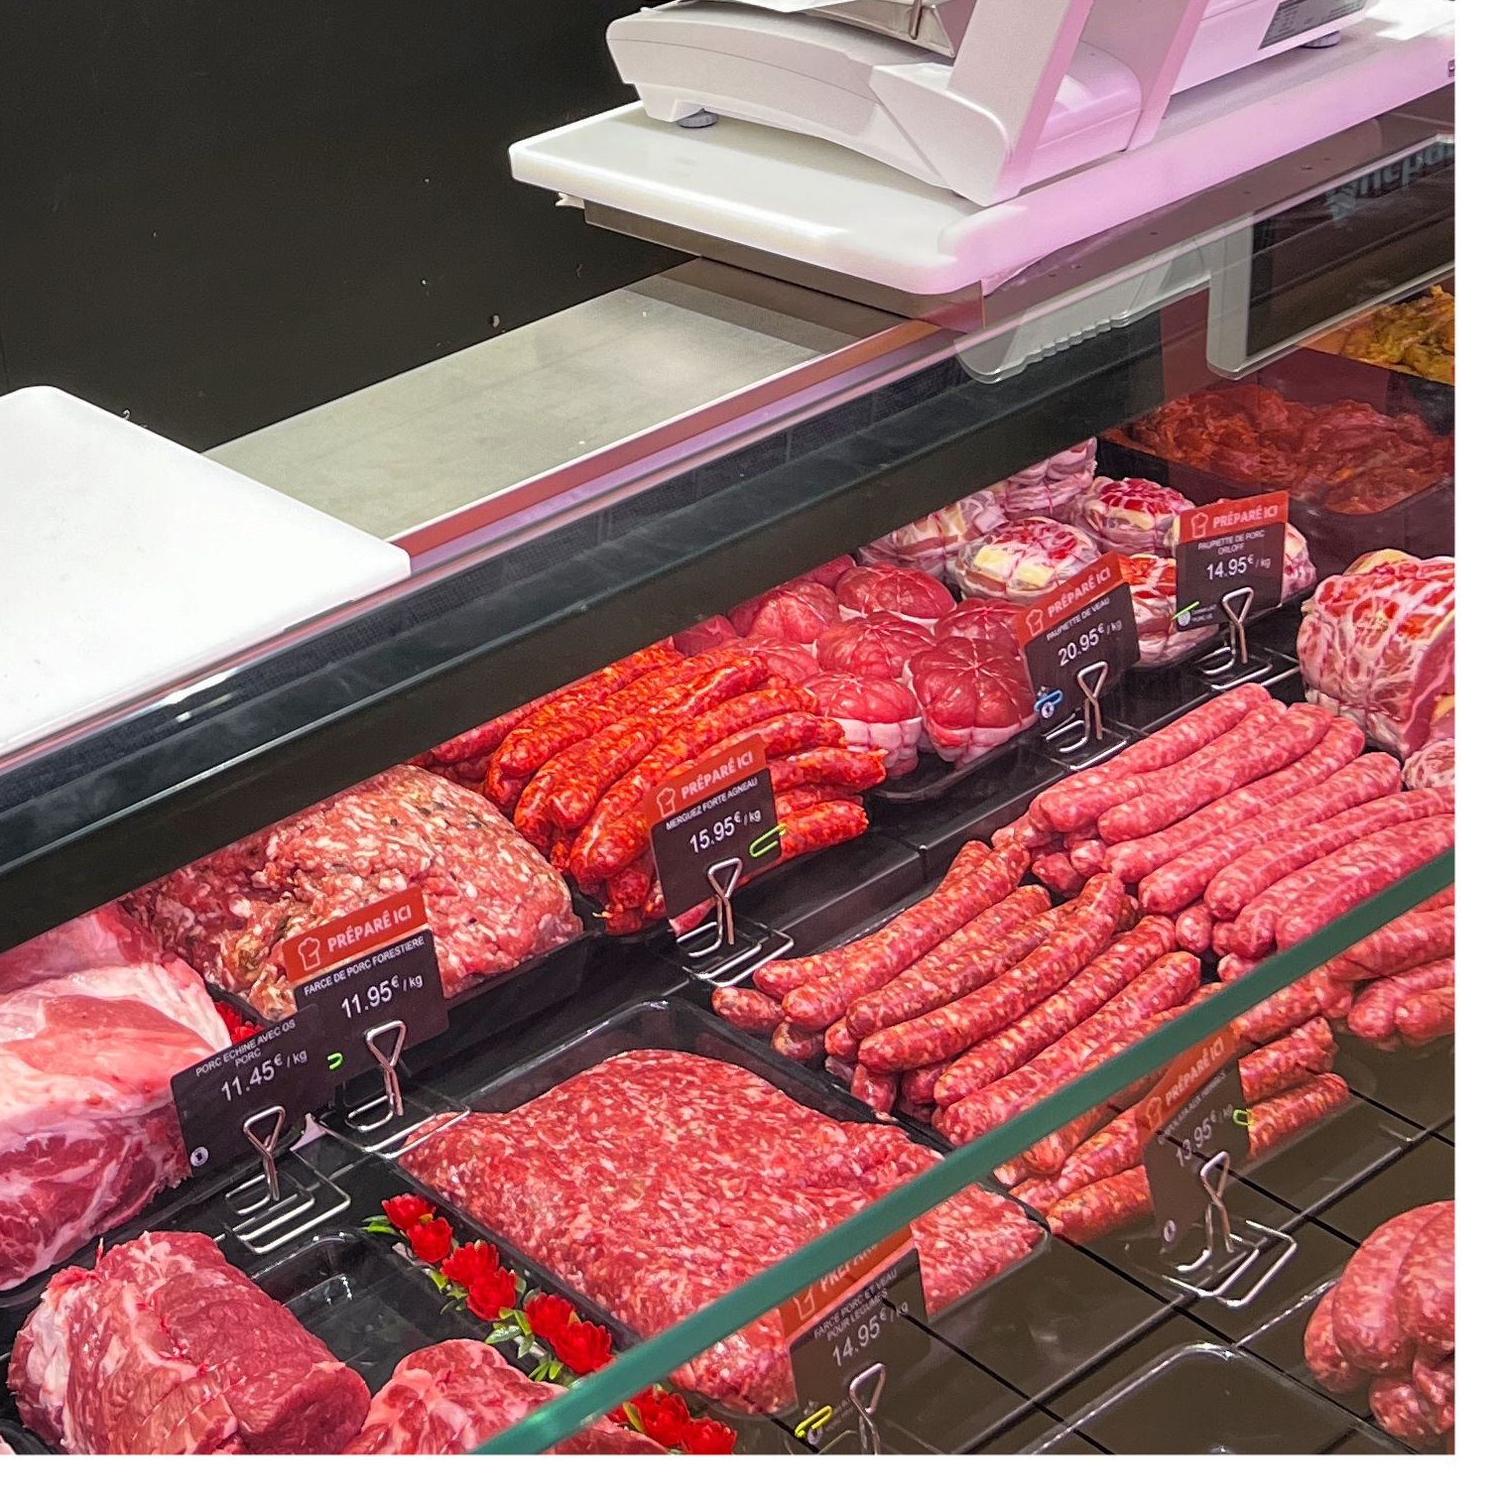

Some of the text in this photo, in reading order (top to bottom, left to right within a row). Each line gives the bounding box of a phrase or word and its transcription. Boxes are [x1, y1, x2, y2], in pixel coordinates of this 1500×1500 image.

[1213, 505, 1263, 528] PRÉPARÉ
[1234, 533, 1245, 542] DE
[1245, 529, 1265, 540] PORC
[1218, 542, 1245, 555] ORLOFF
[1047, 567, 1111, 618] PRÉPARÉ ICI
[1081, 607, 1092, 619] DE
[1091, 597, 1110, 612] VEAU
[680, 752, 754, 800] PRÉPARÉ ICI
[665, 778, 759, 831] MERGUEZ FORTE AGNEAU
[327, 904, 412, 952] PRÉPARÉ ICI
[304, 935, 425, 997] FARCE DE PORC FORESTIERE
[408, 973, 424, 990] kg
[195, 1019, 296, 1077] PORC ECHINE AVEC OS
[235, 1047, 262, 1068] PORC
[292, 1049, 308, 1066] kg
[1165, 1047, 1211, 1106] PRÉPARÉ
[813, 1313, 841, 1339] FARCE
[840, 1295, 863, 1316] PORC
[874, 1268, 898, 1291] VEAU
[826, 1288, 888, 1341] POUR LEGUMES
